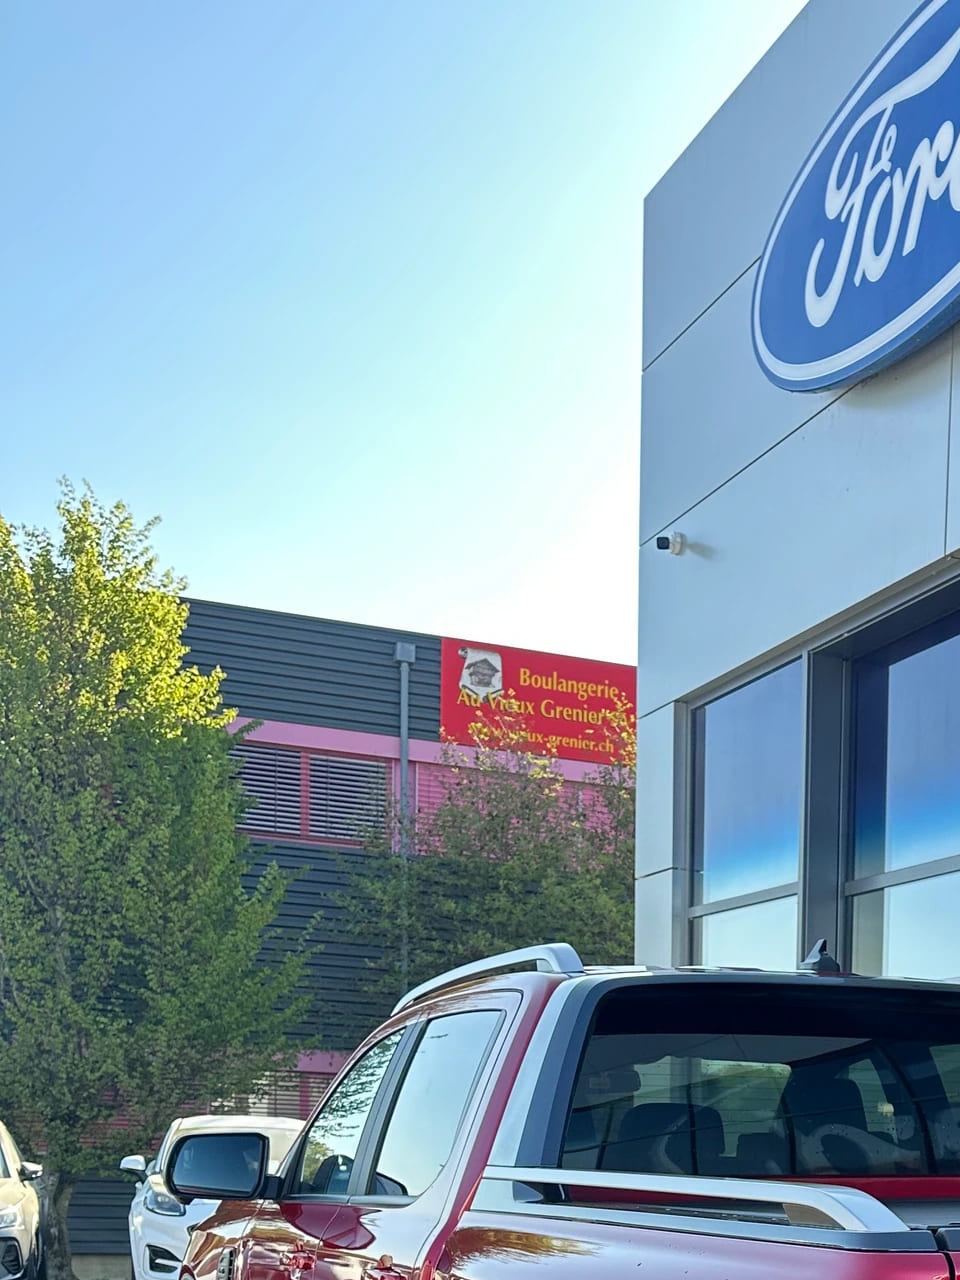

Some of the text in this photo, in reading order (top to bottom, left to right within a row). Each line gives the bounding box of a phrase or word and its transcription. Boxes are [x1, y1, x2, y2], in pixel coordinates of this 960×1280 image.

[519, 667, 619, 701] Boulangerie
[456, 687, 480, 708] Au
[541, 699, 604, 725] Grenier
